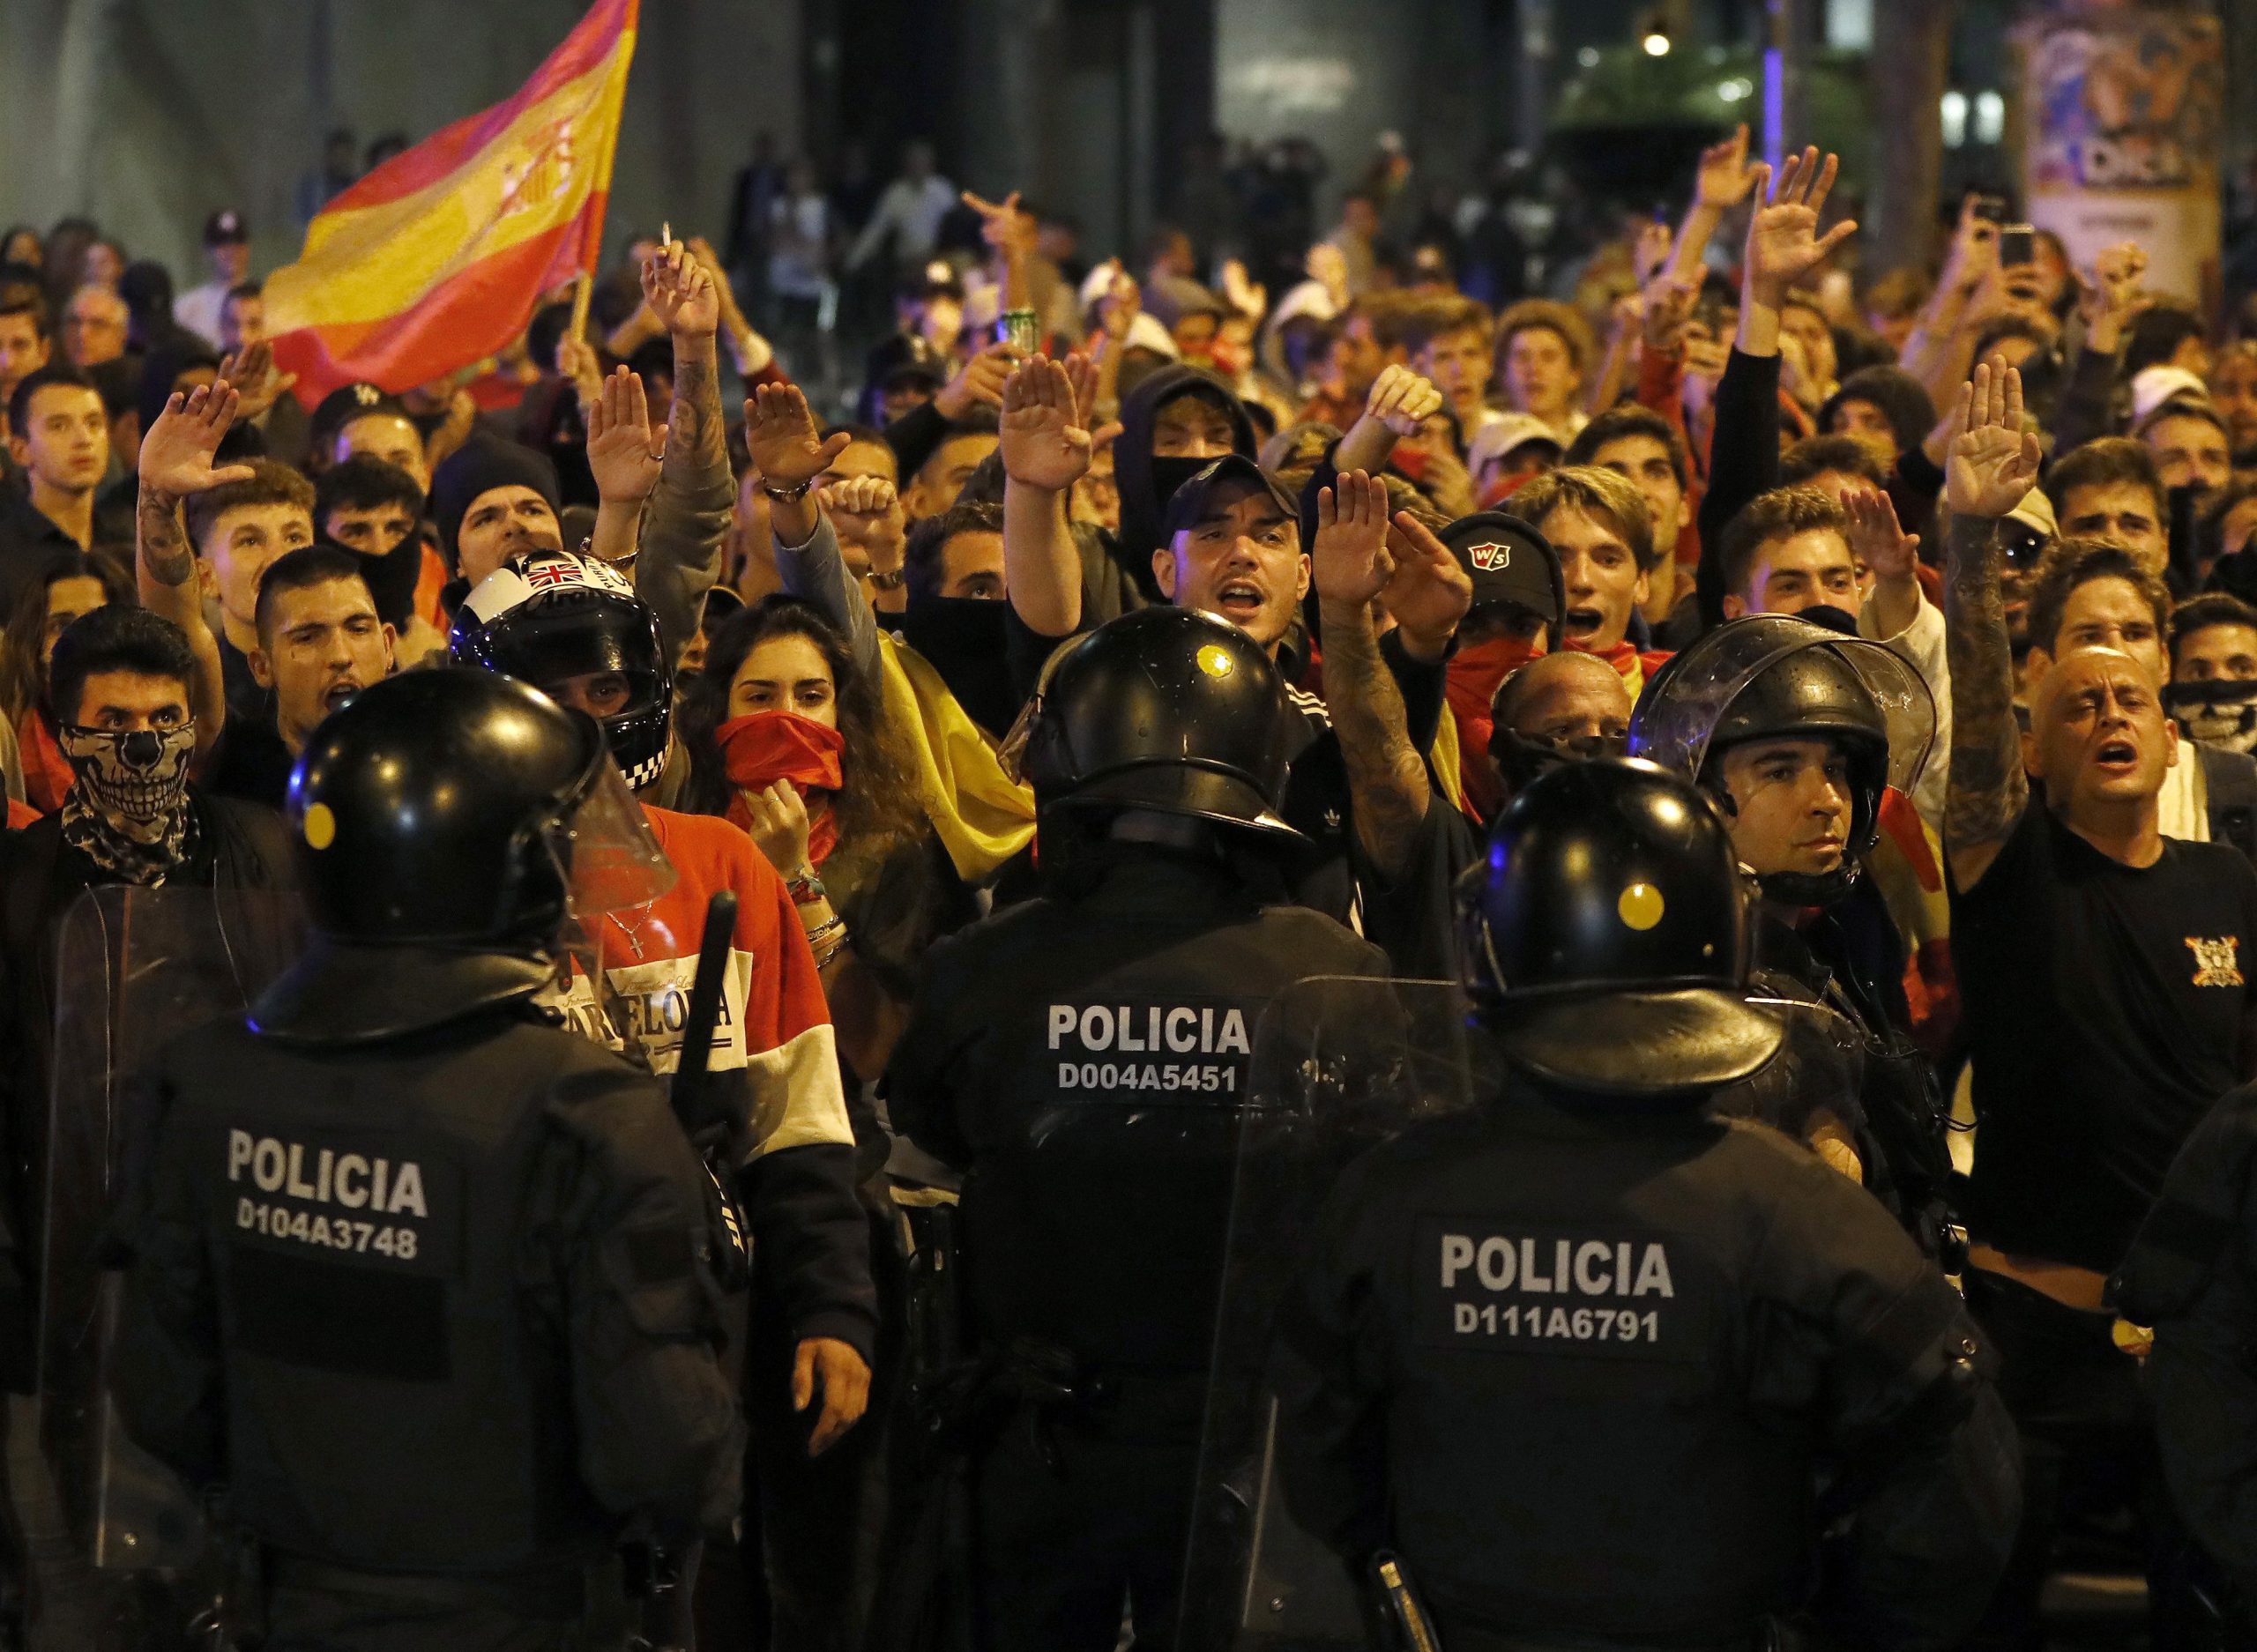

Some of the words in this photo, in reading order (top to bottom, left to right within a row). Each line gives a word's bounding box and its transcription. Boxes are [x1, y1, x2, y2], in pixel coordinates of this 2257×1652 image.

[1048, 1004, 1251, 1054] POLICIA
[1059, 1063, 1235, 1092] D004A5451
[227, 1128, 428, 1218] POLICIA
[237, 1197, 418, 1260] D104A3748
[1441, 1234, 1674, 1298] POLICIA
[1455, 1303, 1658, 1343] D111A6791
